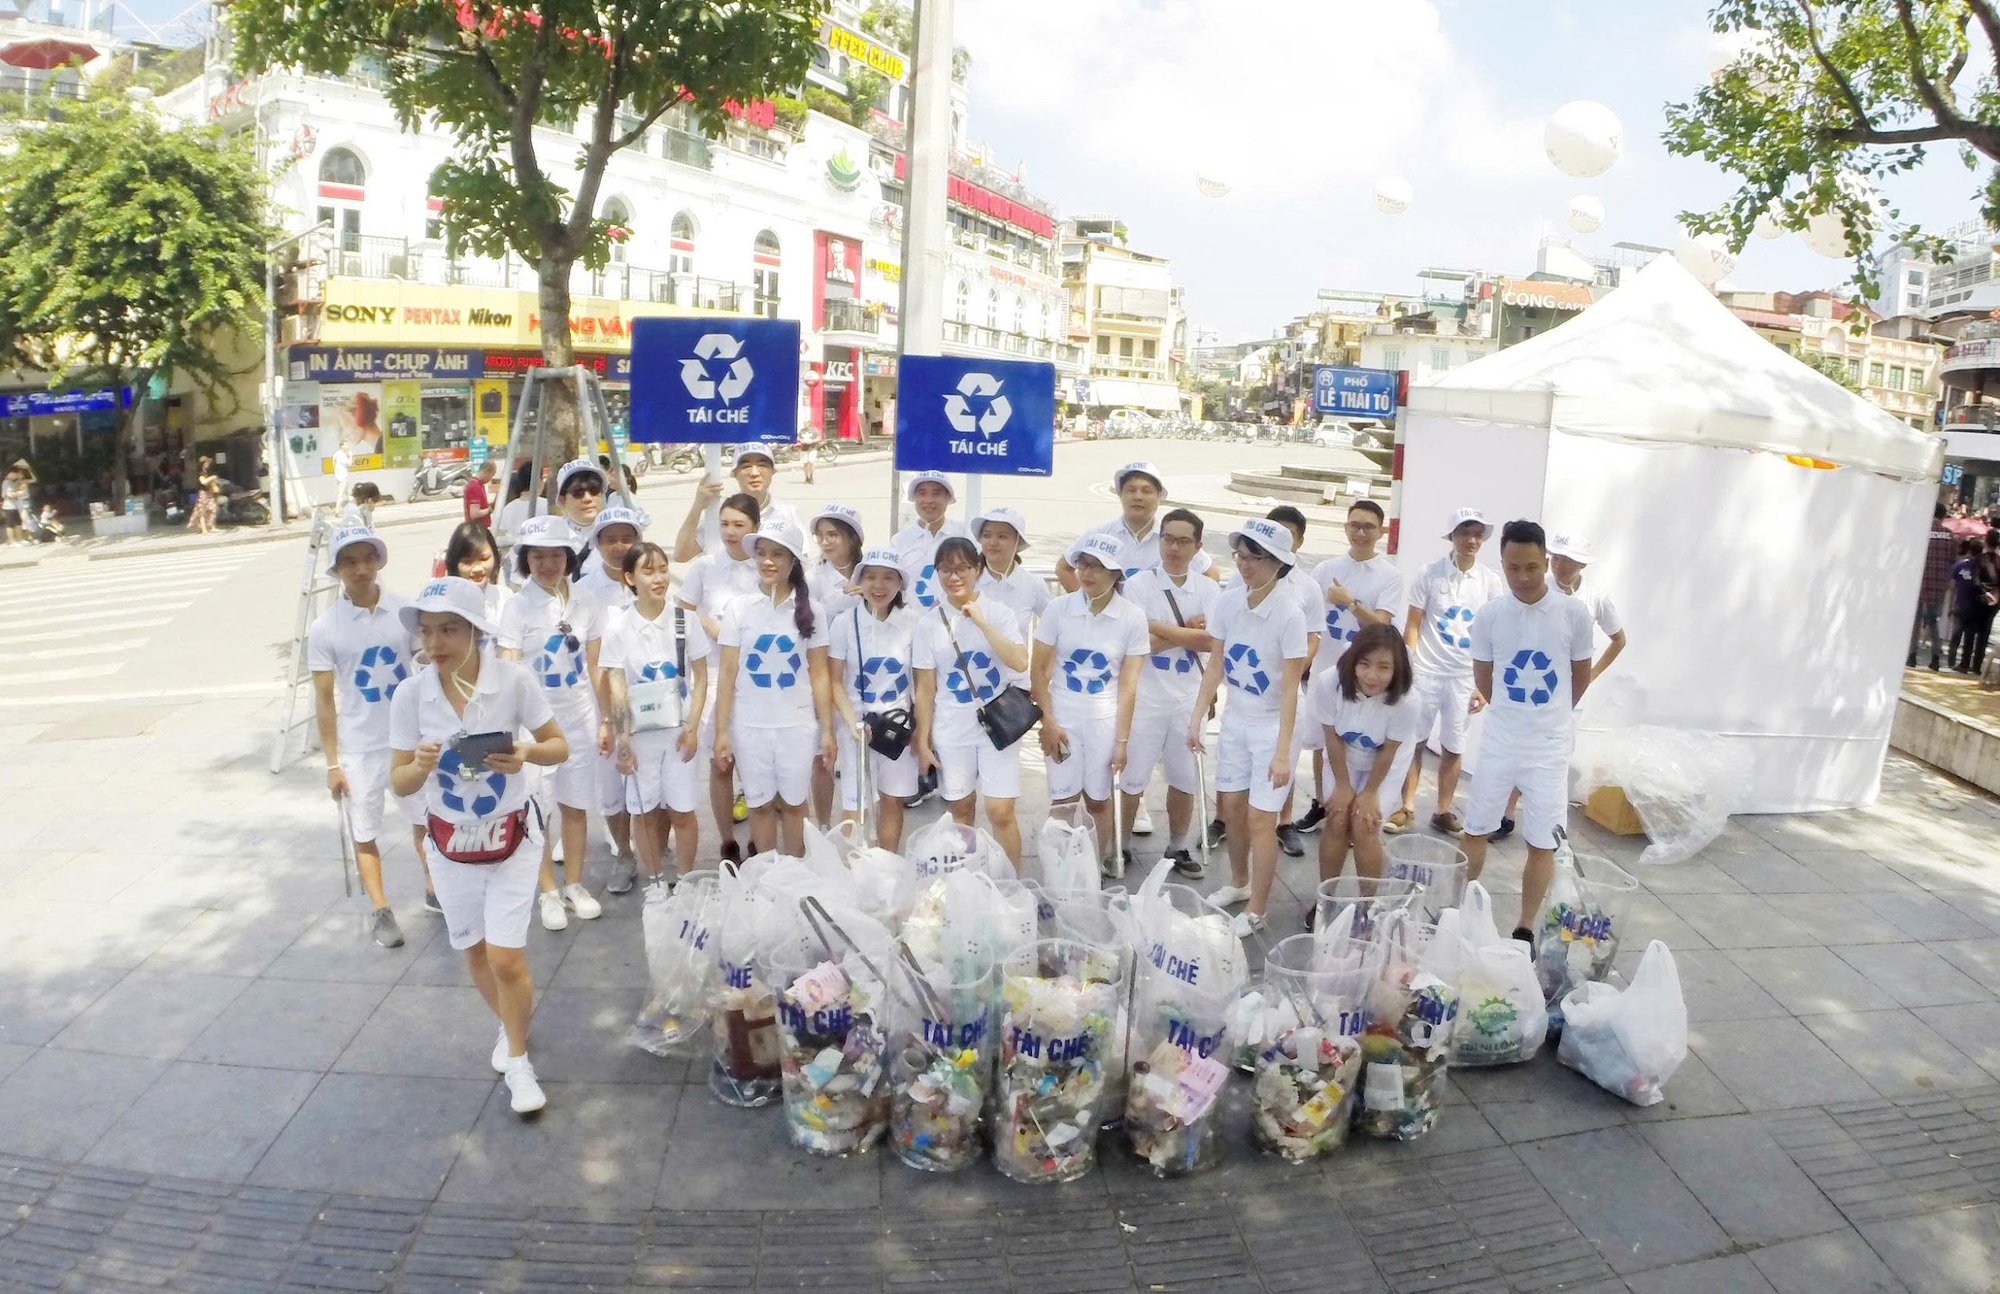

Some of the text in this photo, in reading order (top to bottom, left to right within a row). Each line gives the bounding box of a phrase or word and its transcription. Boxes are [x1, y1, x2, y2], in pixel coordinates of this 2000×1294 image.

[868, 45, 903, 80] CLUB
[326, 303, 512, 327] SONY PENTAX Nikon
[1557, 301, 1588, 311] CAPH
[309, 353, 328, 370] IN
[333, 347, 371, 371] ẢNH
[384, 352, 430, 373] CHỤP
[434, 348, 468, 371] ẢNH
[825, 360, 854, 377] KFC
[354, 371, 373, 379] Photo
[374, 371, 399, 380] Printing
[401, 371, 412, 379] and
[1344, 374, 1368, 387] PHỐ
[1320, 387, 1391, 411] LÊ THÁI TỔ
[686, 405, 749, 423] TÁI CHẾ
[949, 438, 1008, 456] TÁI CHẾ
[446, 816, 508, 853] NIKE
[1167, 956, 1200, 985] CHẾ
[1013, 1019, 1041, 1058] TÁI
[1168, 1019, 1195, 1053] TÁI
